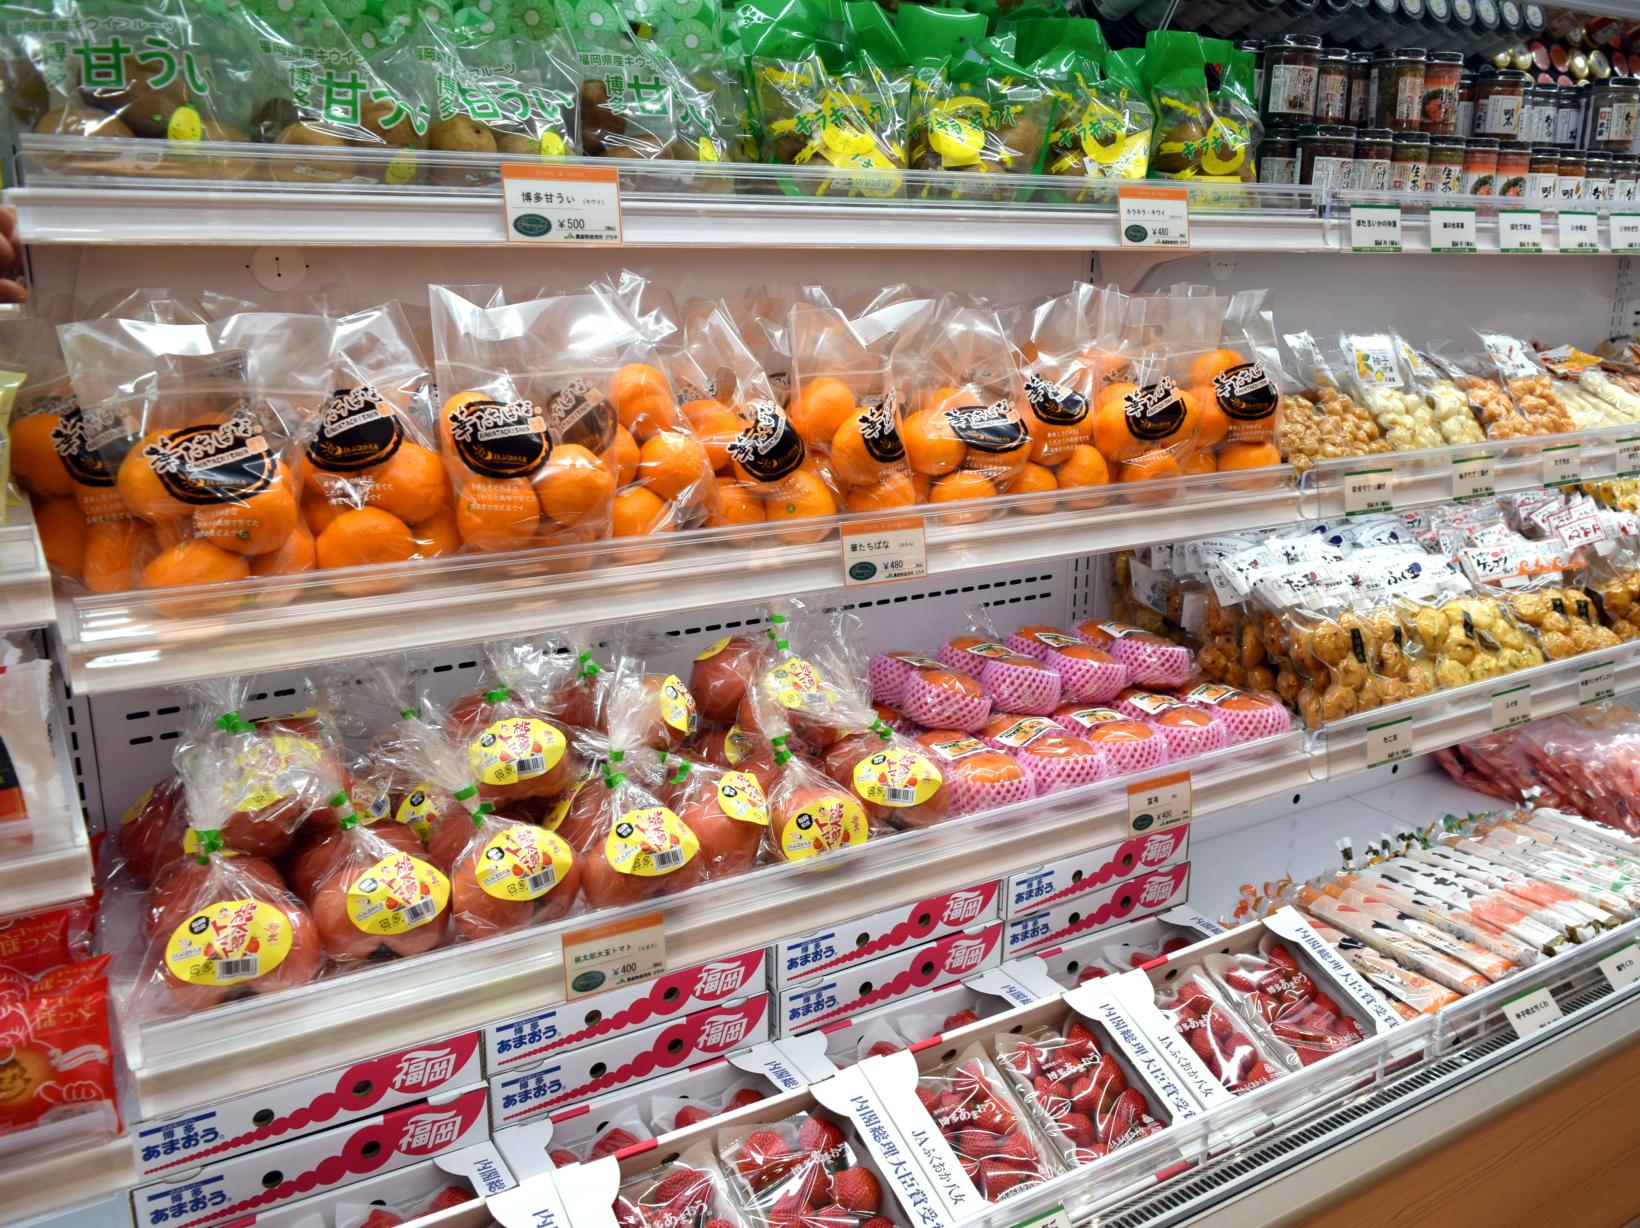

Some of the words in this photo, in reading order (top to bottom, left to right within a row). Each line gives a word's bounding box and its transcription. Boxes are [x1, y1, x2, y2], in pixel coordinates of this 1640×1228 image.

[437, 72, 460, 121] 博多
[605, 75, 627, 115] 博多
[521, 191, 576, 204] 博多甘うい
[556, 218, 585, 230] ¥500
[1151, 227, 1169, 236] ¥480
[448, 401, 533, 442] 華たちばな
[850, 540, 890, 552] 華たちばな
[882, 559, 904, 570] ¥480
[830, 801, 845, 842] 桃太郎
[1140, 834, 1174, 863] 福岡
[1014, 882, 1054, 905] あまおう
[1140, 875, 1174, 905] 福岡
[942, 891, 984, 922] 福岡
[229, 902, 258, 951] 桃太郎
[1009, 923, 1050, 946] あまおう
[574, 944, 632, 963] 桃太郎大玉トマト
[787, 944, 836, 970] あまおう
[943, 939, 986, 970] 福岡
[612, 962, 637, 976] ¥400
[694, 961, 743, 996] 福岡
[789, 995, 837, 1021] あまおう
[497, 1024, 557, 1055] あまおう
[514, 1022, 539, 1036] 博多
[697, 1012, 747, 1048] 福岡
[392, 1048, 457, 1089] 福岡
[1156, 1034, 1216, 1097] JAふくおか八女
[502, 1080, 563, 1109] あまおう
[519, 1077, 545, 1091] 博多
[937, 1100, 996, 1127] 博多あまおう
[141, 1128, 219, 1162] あまおう
[162, 1124, 195, 1141] 博多
[398, 1109, 462, 1152] 福岡
[911, 1129, 967, 1206] JAふくおか八女
[149, 1190, 228, 1225] あまおう
[171, 1186, 204, 1204] 博多
